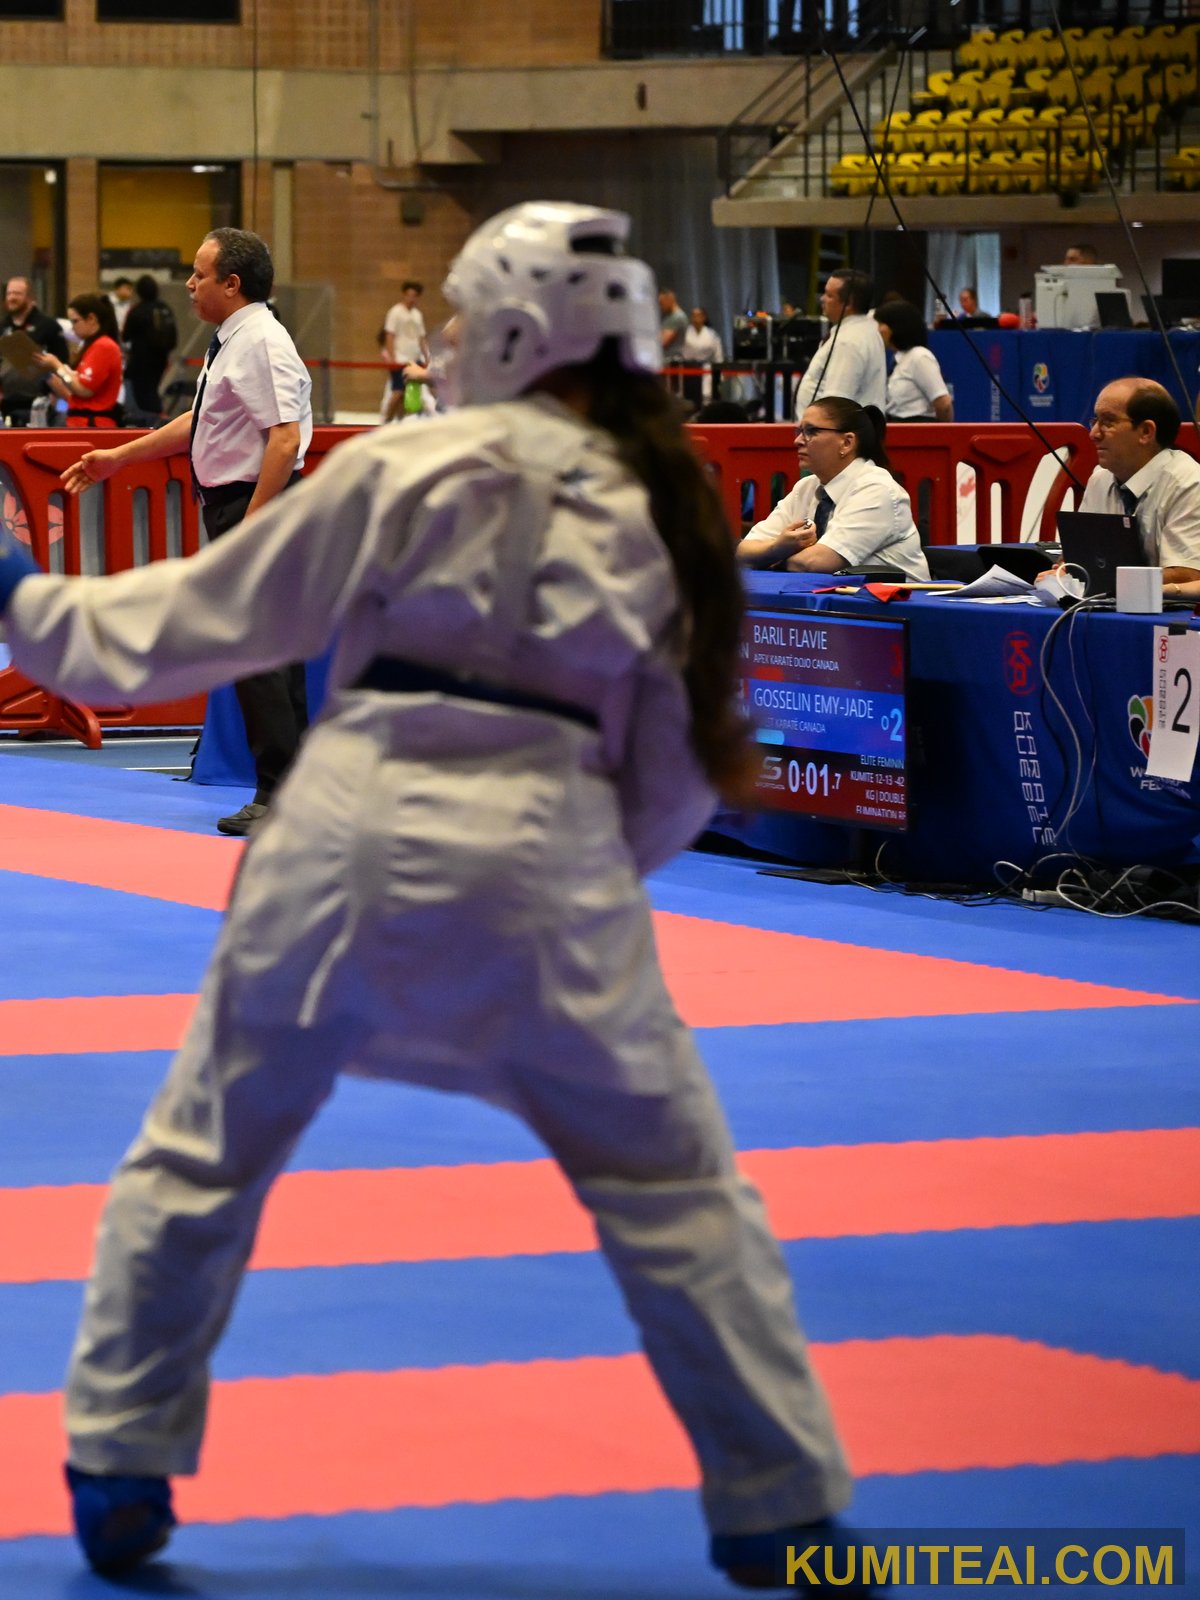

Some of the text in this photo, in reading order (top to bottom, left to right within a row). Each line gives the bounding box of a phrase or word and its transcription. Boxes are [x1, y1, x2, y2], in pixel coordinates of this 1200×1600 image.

[754, 625, 827, 650] BARIL FLAVIE
[812, 659, 839, 672] CANADA
[754, 688, 811, 712] GOSSELIN
[814, 694, 874, 719] EMY-JADE
[1171, 667, 1191, 734] 2
